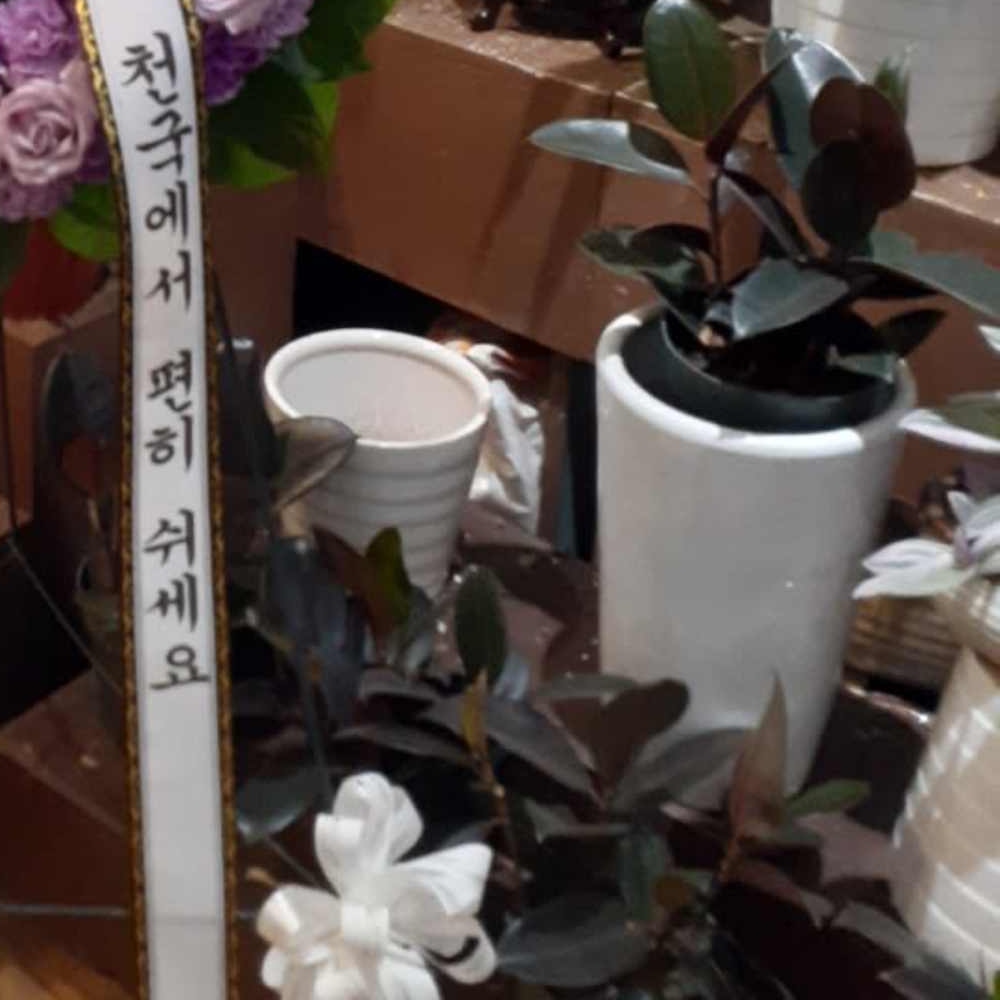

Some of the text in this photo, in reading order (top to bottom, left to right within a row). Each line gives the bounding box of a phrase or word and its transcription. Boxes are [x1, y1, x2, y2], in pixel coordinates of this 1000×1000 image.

[121, 31, 193, 310] 천국에서
[144, 349, 193, 471] 편히
[142, 508, 212, 690] 쉬세요
